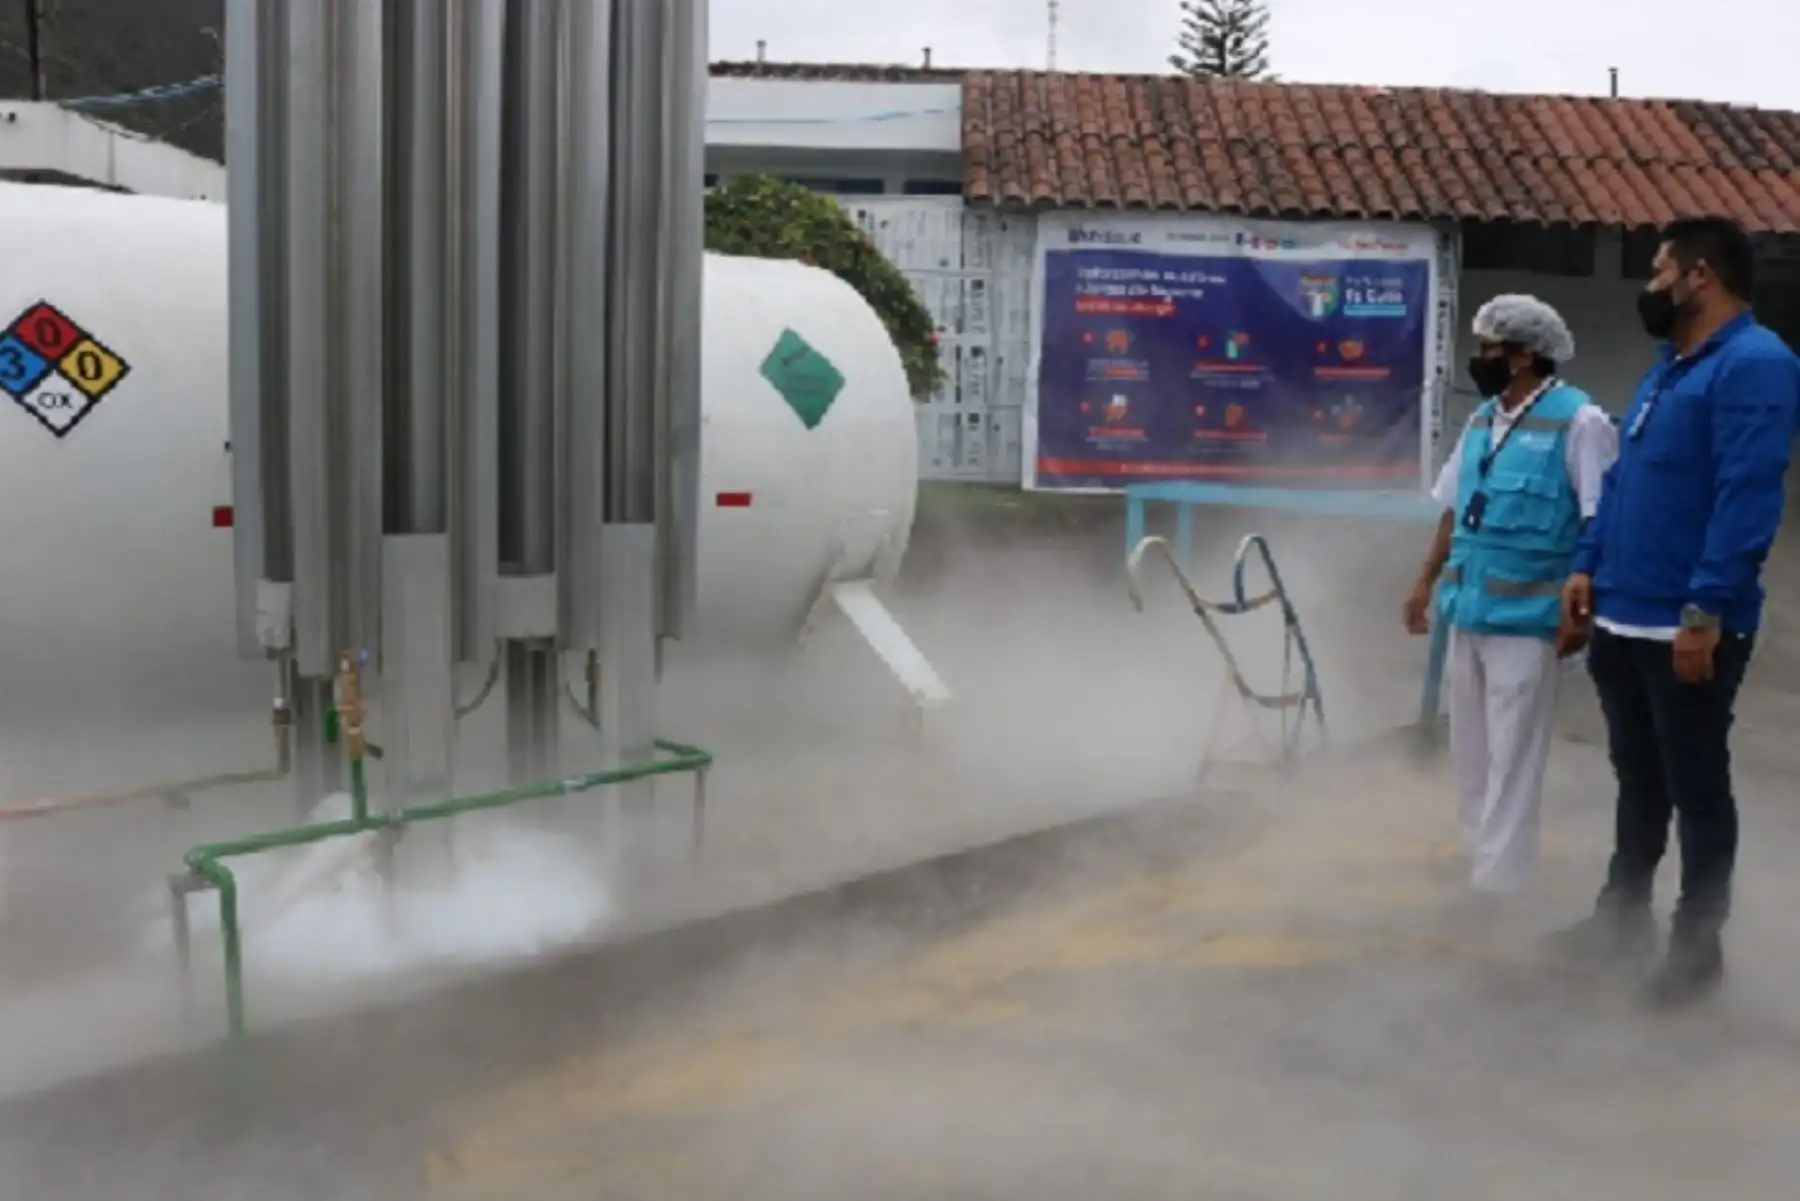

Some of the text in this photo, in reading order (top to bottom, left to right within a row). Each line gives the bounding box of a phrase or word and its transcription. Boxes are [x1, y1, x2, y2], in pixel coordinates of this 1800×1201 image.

[36, 317, 61, 346] 0
[0, 347, 26, 380] 3
[77, 351, 103, 380] 0
[37, 391, 73, 409] OX
